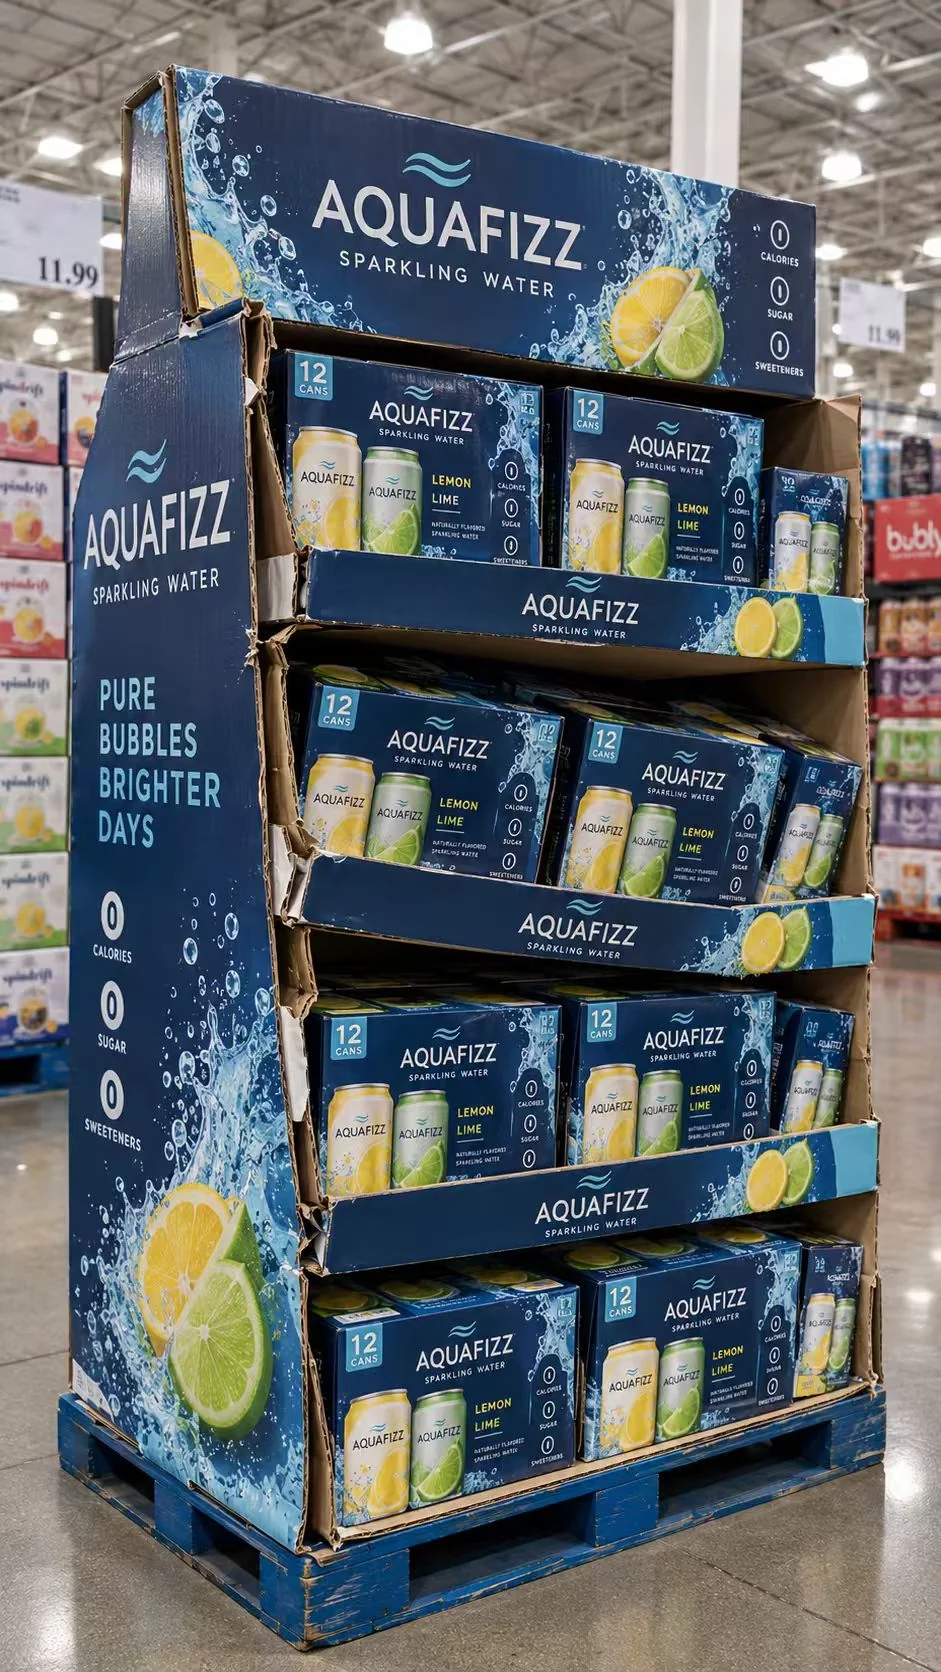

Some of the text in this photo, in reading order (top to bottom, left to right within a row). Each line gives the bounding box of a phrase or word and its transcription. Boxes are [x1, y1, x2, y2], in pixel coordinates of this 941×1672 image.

[312, 180, 582, 270] AQUAFIZZ
[761, 252, 799, 267] CALORIES
[38, 257, 98, 288] 11.99
[340, 251, 554, 298] SPARKLING WATER
[767, 309, 793, 321] SUGAR
[300, 361, 327, 384] 12
[755, 361, 804, 376] SWEETENERS
[299, 384, 329, 396] CANS
[369, 400, 473, 432] AQUAFIZZ
[577, 398, 599, 420] 12
[576, 420, 600, 431] CANS
[379, 428, 464, 445] SPARKLING WATER
[628, 435, 711, 464] AQUAFIZZ
[636, 460, 704, 476] SPARKLING WATER
[301, 471, 355, 487] AQUAFIZZ
[432, 475, 471, 488] LEMON
[369, 486, 417, 500] AQUAFIZZ
[432, 493, 459, 505] LIME
[576, 500, 618, 513] AQUAFIZZ
[677, 503, 708, 515] LEMON
[83, 479, 230, 570] AQUAFIZZ
[629, 513, 665, 526] AQUAFIZZ
[677, 520, 699, 531] LIME
[886, 520, 941, 558] bubly
[93, 568, 219, 605] SPARKLING WATER
[522, 593, 639, 624] AQUAFIZZ
[532, 624, 626, 639] SPARKLING WATER
[100, 677, 155, 711] PURE
[326, 694, 352, 716] 12
[323, 716, 351, 726] CANS
[100, 722, 198, 758] BUBBLES
[387, 730, 489, 759] AQUAFIZZ
[596, 729, 616, 750] 12
[592, 749, 616, 760] CANS
[394, 755, 477, 772] SPARKLING WATER
[642, 763, 726, 791] AQUAFIZZ
[100, 767, 221, 808] BRIGHTER
[647, 787, 715, 802] SPARKLING WATER
[313, 793, 365, 808] AQUAFIZZ
[440, 797, 478, 810] LEMON
[377, 808, 423, 821] AQUAFIZZ
[437, 815, 464, 826] LIME
[99, 810, 154, 848] DAYS
[581, 822, 624, 837] AQUAFIZZ
[683, 827, 714, 838] LEMON
[632, 835, 669, 849] AQUAFIZZ
[680, 843, 702, 853] LIME
[518, 913, 638, 946] AQUAFIZZ
[93, 944, 132, 964] CALORIES
[527, 942, 621, 960] SPARKLING WATER
[592, 1009, 612, 1028] 12
[335, 1024, 361, 1045] 12
[590, 1028, 613, 1040] CANS
[643, 1026, 724, 1051] AQUAFIZZ
[97, 1034, 127, 1054] SUGAR
[335, 1046, 362, 1056] CANS
[400, 1043, 497, 1069] AQUAFIZZ
[650, 1050, 717, 1063] SPARKLING WATER
[409, 1068, 489, 1082] SPARKLING WATER
[690, 1084, 720, 1095] LEMON
[457, 1106, 494, 1118] LEMON
[591, 1100, 632, 1114] AQUAFIZZ
[643, 1103, 678, 1116] AQUAFIZZ
[689, 1101, 710, 1111] LIME
[84, 1118, 142, 1152] SWEETENERS
[335, 1123, 387, 1138] AQUAFIZZ
[399, 1126, 443, 1139] AQUAFIZZ
[457, 1124, 482, 1135] LIME
[535, 1187, 649, 1224] AQUAFIZZ
[545, 1217, 637, 1238] SPARKLING WATER
[610, 1285, 632, 1306] 12
[609, 1305, 632, 1318] CANS
[664, 1287, 747, 1322] AQUAFIZZ
[672, 1312, 740, 1332] SPARKLING WATER
[351, 1332, 377, 1355] 12
[351, 1355, 378, 1366] CANS
[416, 1334, 513, 1371] AQUAFIZZ
[712, 1345, 744, 1360] LEMON
[424, 1361, 506, 1384] SPARKLING WATER
[712, 1363, 733, 1376] LIME
[609, 1374, 653, 1393] AQUAFIZZ
[663, 1370, 700, 1386] AQUAFIZZ
[475, 1398, 512, 1414] LEMON
[475, 1417, 500, 1432] LIME
[539, 1421, 557, 1430] SUGAR
[352, 1429, 404, 1451] AQUAFIZZ
[417, 1425, 461, 1444] AQUAFIZZ
